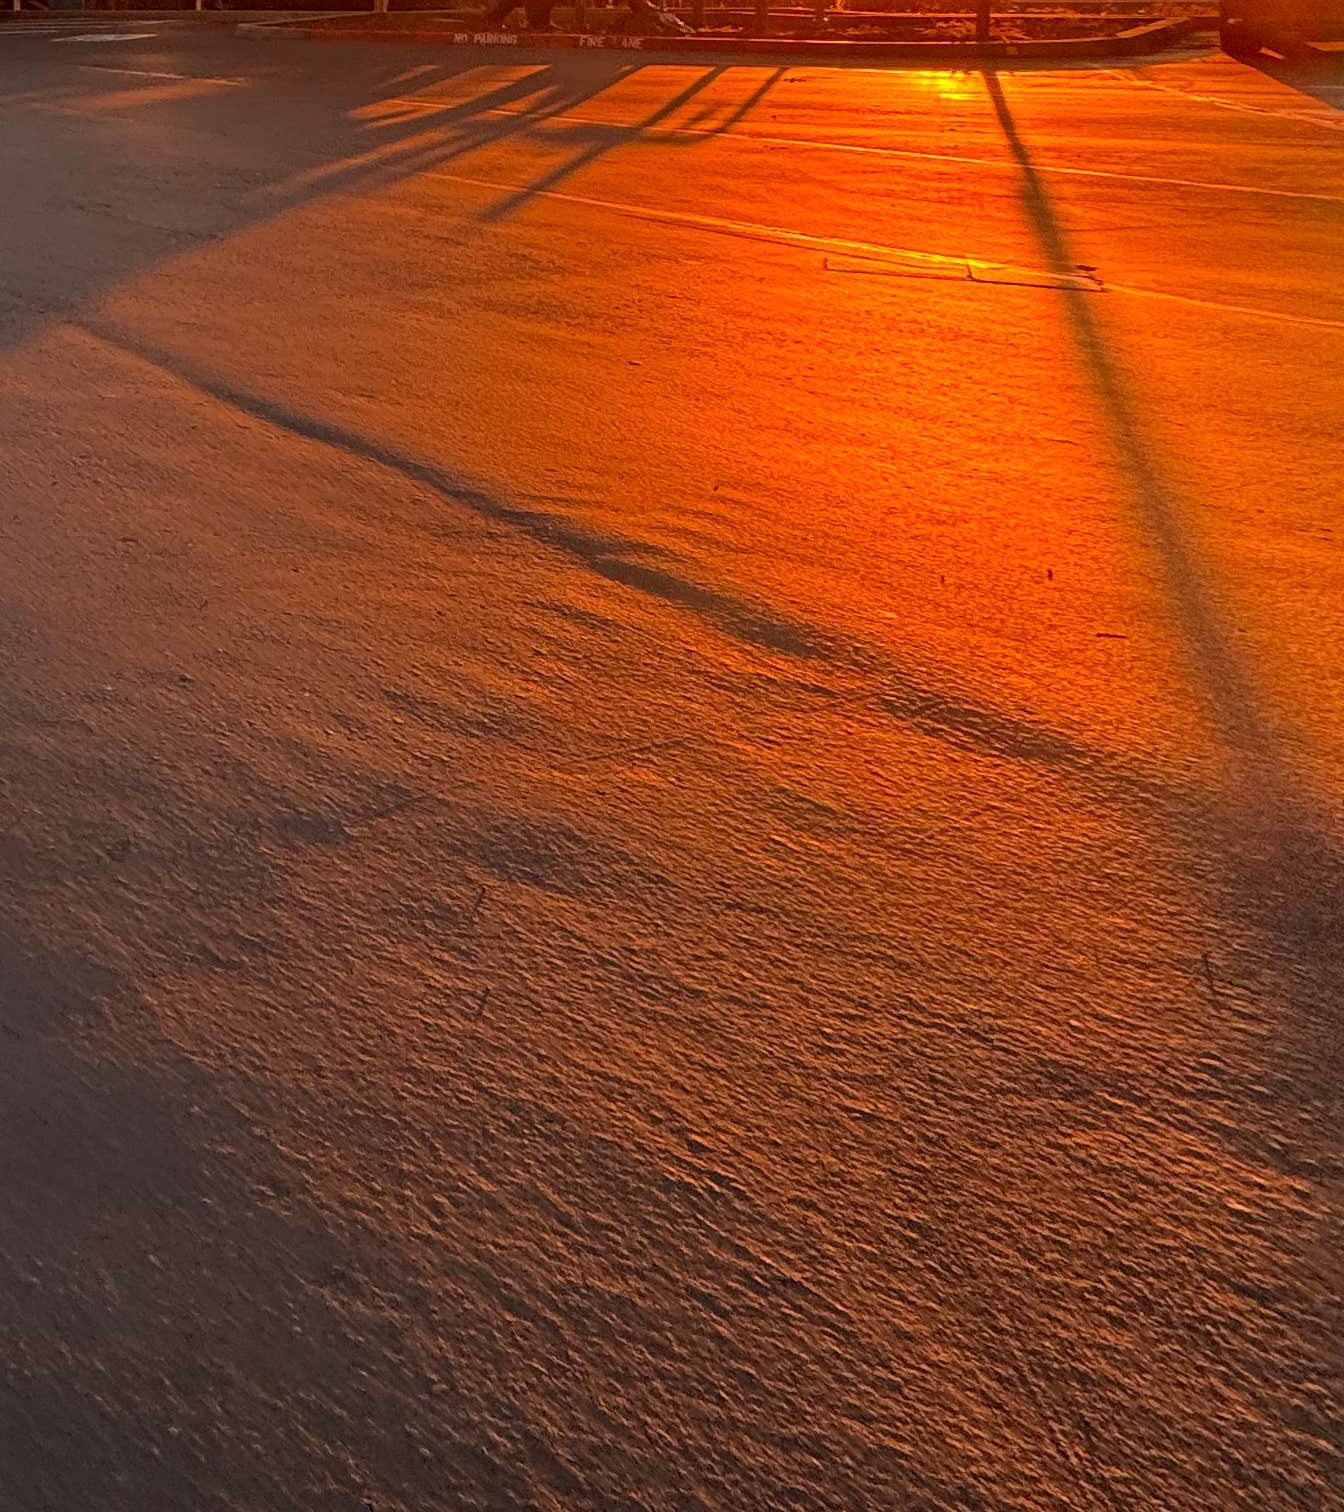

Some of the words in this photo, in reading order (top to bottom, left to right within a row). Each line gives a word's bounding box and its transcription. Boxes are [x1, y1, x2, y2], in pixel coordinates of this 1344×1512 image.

[454, 33, 468, 43] NO
[473, 33, 518, 45] PARKING
[579, 37, 606, 48] FIRE
